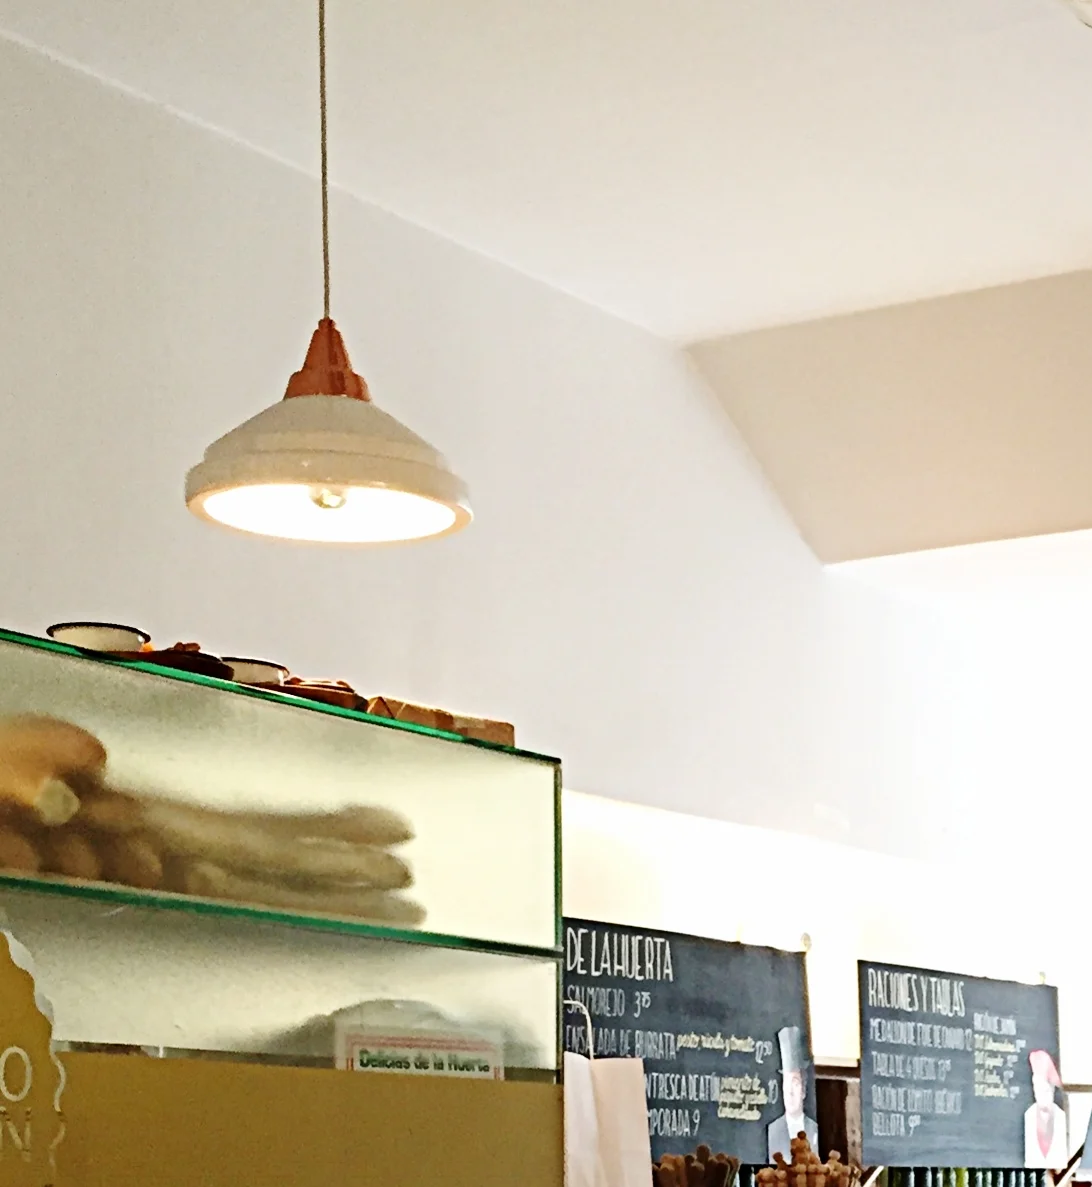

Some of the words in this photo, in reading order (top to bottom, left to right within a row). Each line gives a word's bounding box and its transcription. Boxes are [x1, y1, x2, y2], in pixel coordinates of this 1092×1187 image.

[566, 926, 588, 975] DE
[591, 930, 611, 977] LA
[613, 932, 673, 982] HUERTA
[566, 984, 625, 1017] SALMOREJO
[868, 967, 919, 1013] RACIONES
[920, 974, 928, 1013] Y
[929, 976, 965, 1018] TABLAS
[358, 1048, 410, 1069] Delicias
[412, 1050, 429, 1070] de
[431, 1051, 444, 1071] la
[446, 1052, 490, 1073] Huerta
[635, 1030, 676, 1061] BURRATA
